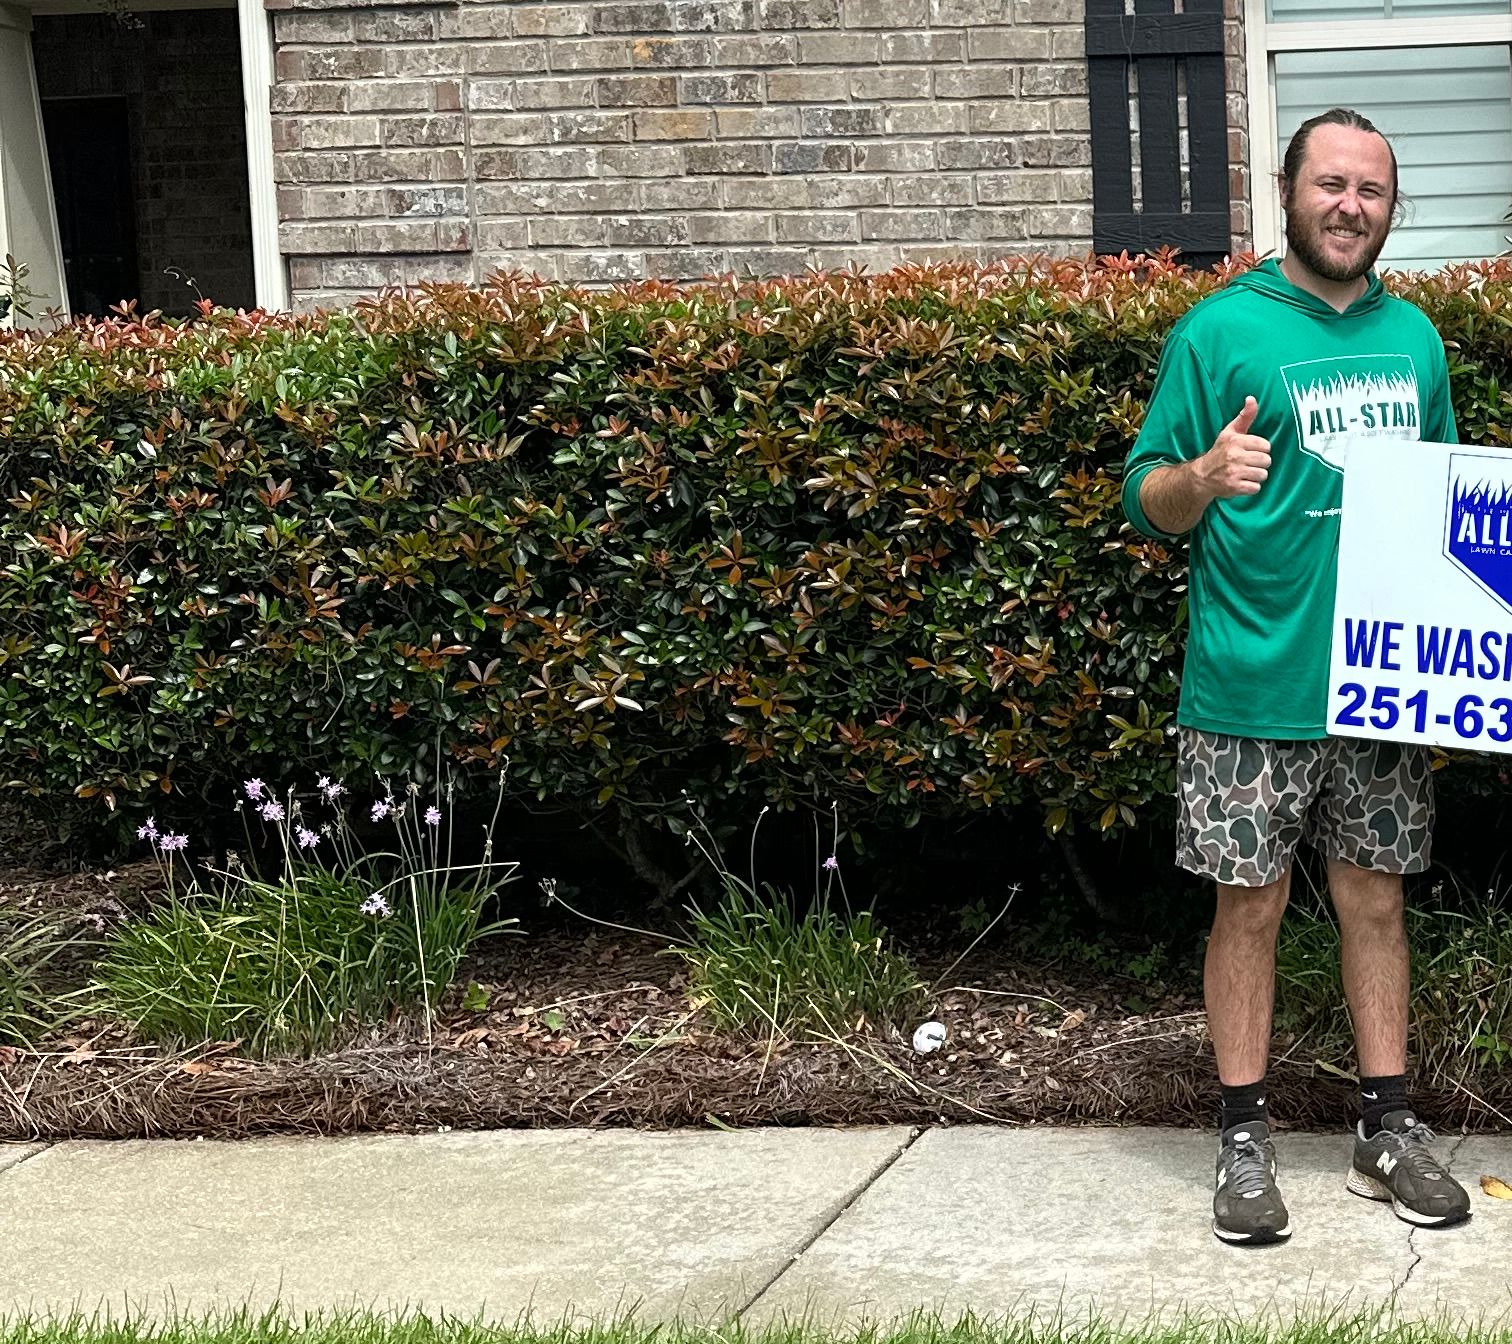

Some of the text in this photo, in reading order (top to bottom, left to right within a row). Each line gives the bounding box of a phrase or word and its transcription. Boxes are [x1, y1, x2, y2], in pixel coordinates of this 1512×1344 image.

[1310, 401, 1417, 436] ALL-STAR
[1470, 545, 1496, 555] LAWN
[1344, 618, 1404, 670] WE
